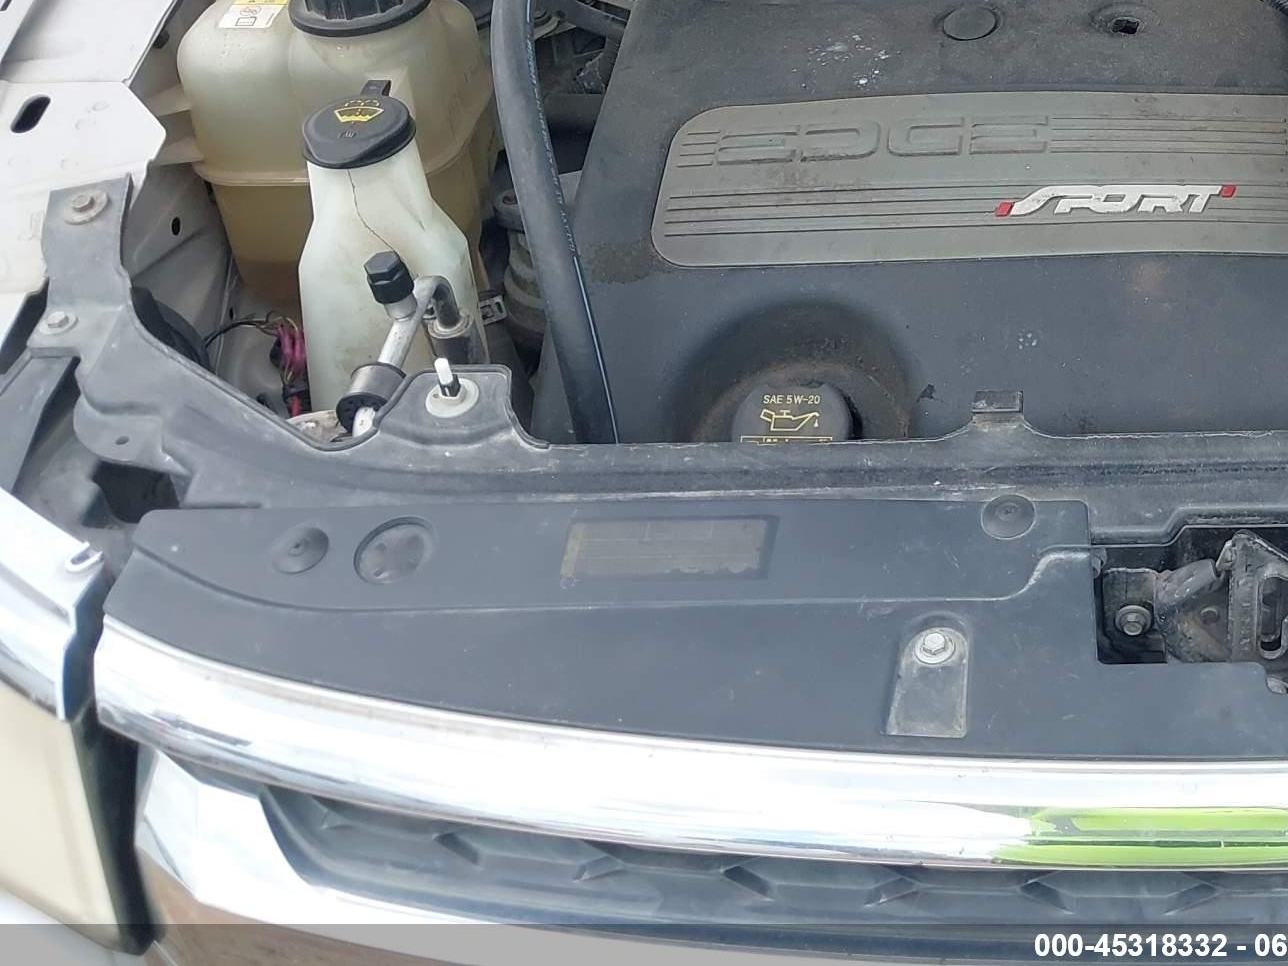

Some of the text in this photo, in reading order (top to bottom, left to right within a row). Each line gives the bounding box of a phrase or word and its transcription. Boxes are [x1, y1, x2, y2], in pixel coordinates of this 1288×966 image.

[716, 115, 1048, 166] EDGE
[1009, 184, 1223, 216] SPORT
[763, 394, 821, 405] SAE 5W-20
